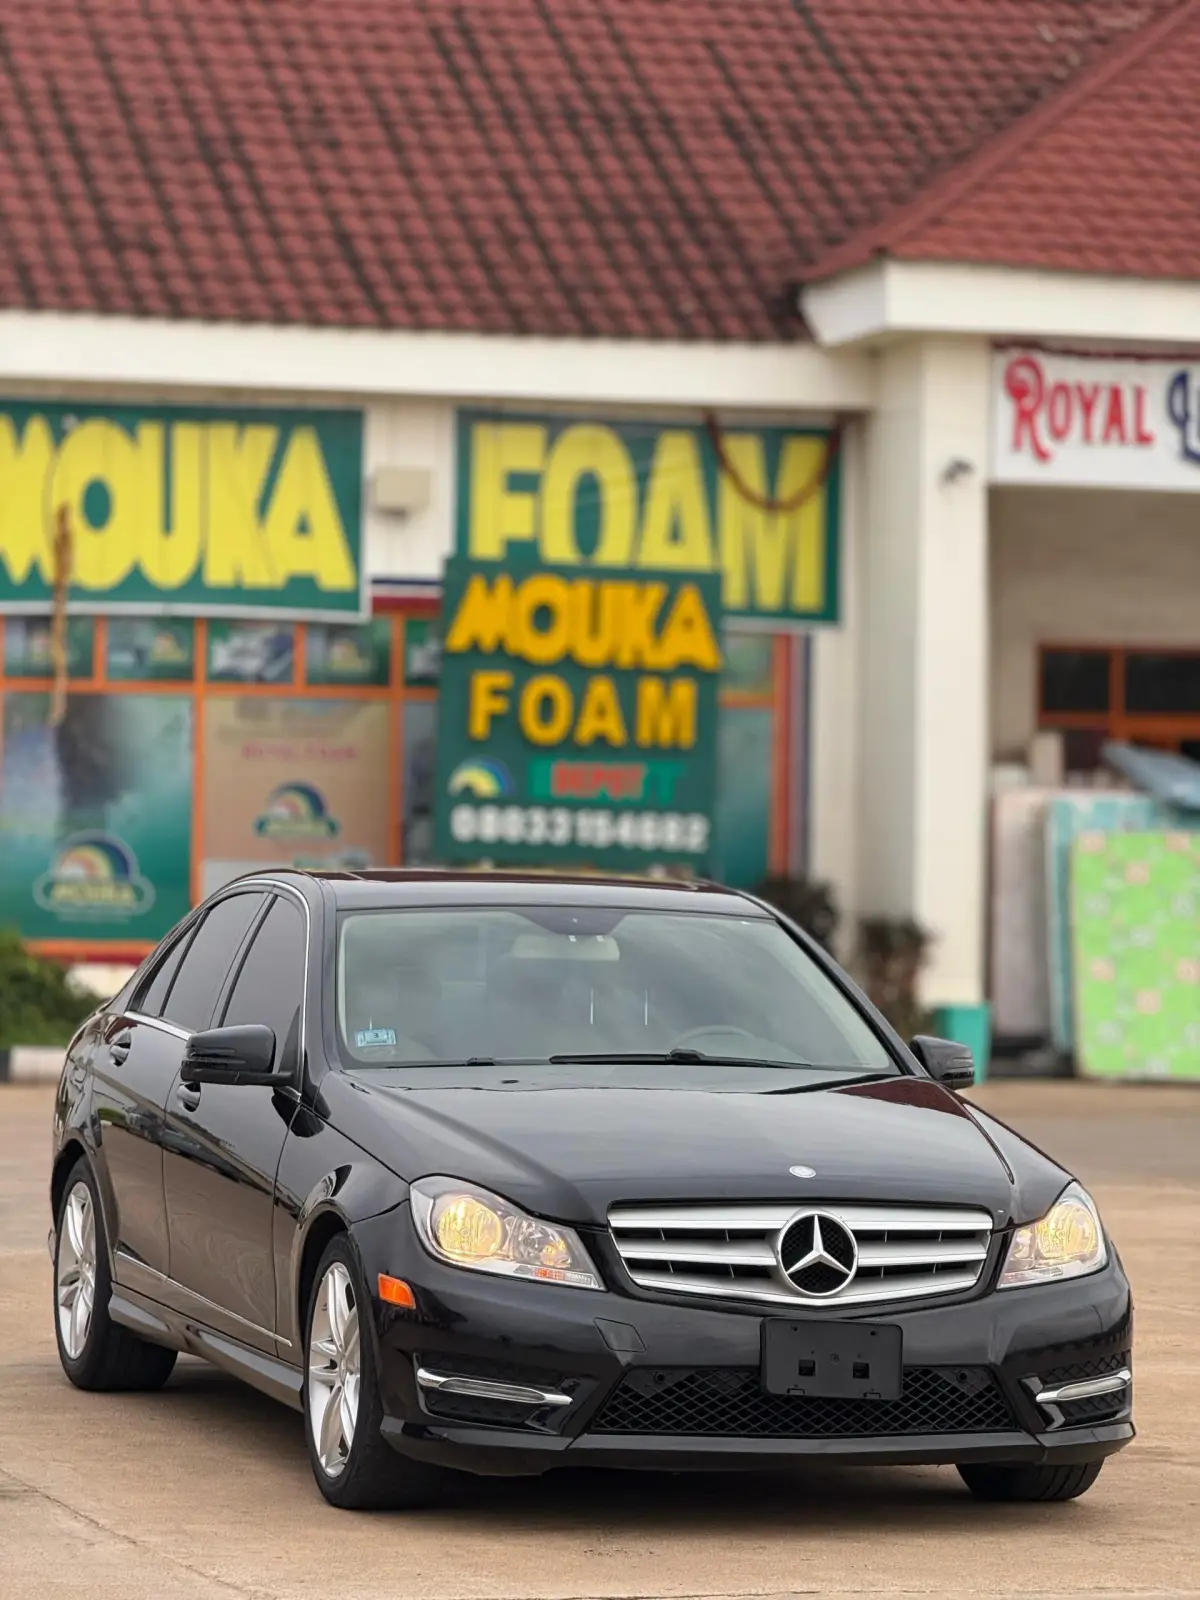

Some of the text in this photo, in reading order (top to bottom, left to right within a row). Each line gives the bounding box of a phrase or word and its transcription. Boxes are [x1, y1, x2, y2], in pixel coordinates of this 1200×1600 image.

[1003, 353, 1156, 463] ROYAL
[0, 414, 357, 591] MOUKA
[468, 421, 827, 611] FOAM
[445, 572, 723, 672] MOUKA
[467, 668, 698, 749] FOAM
